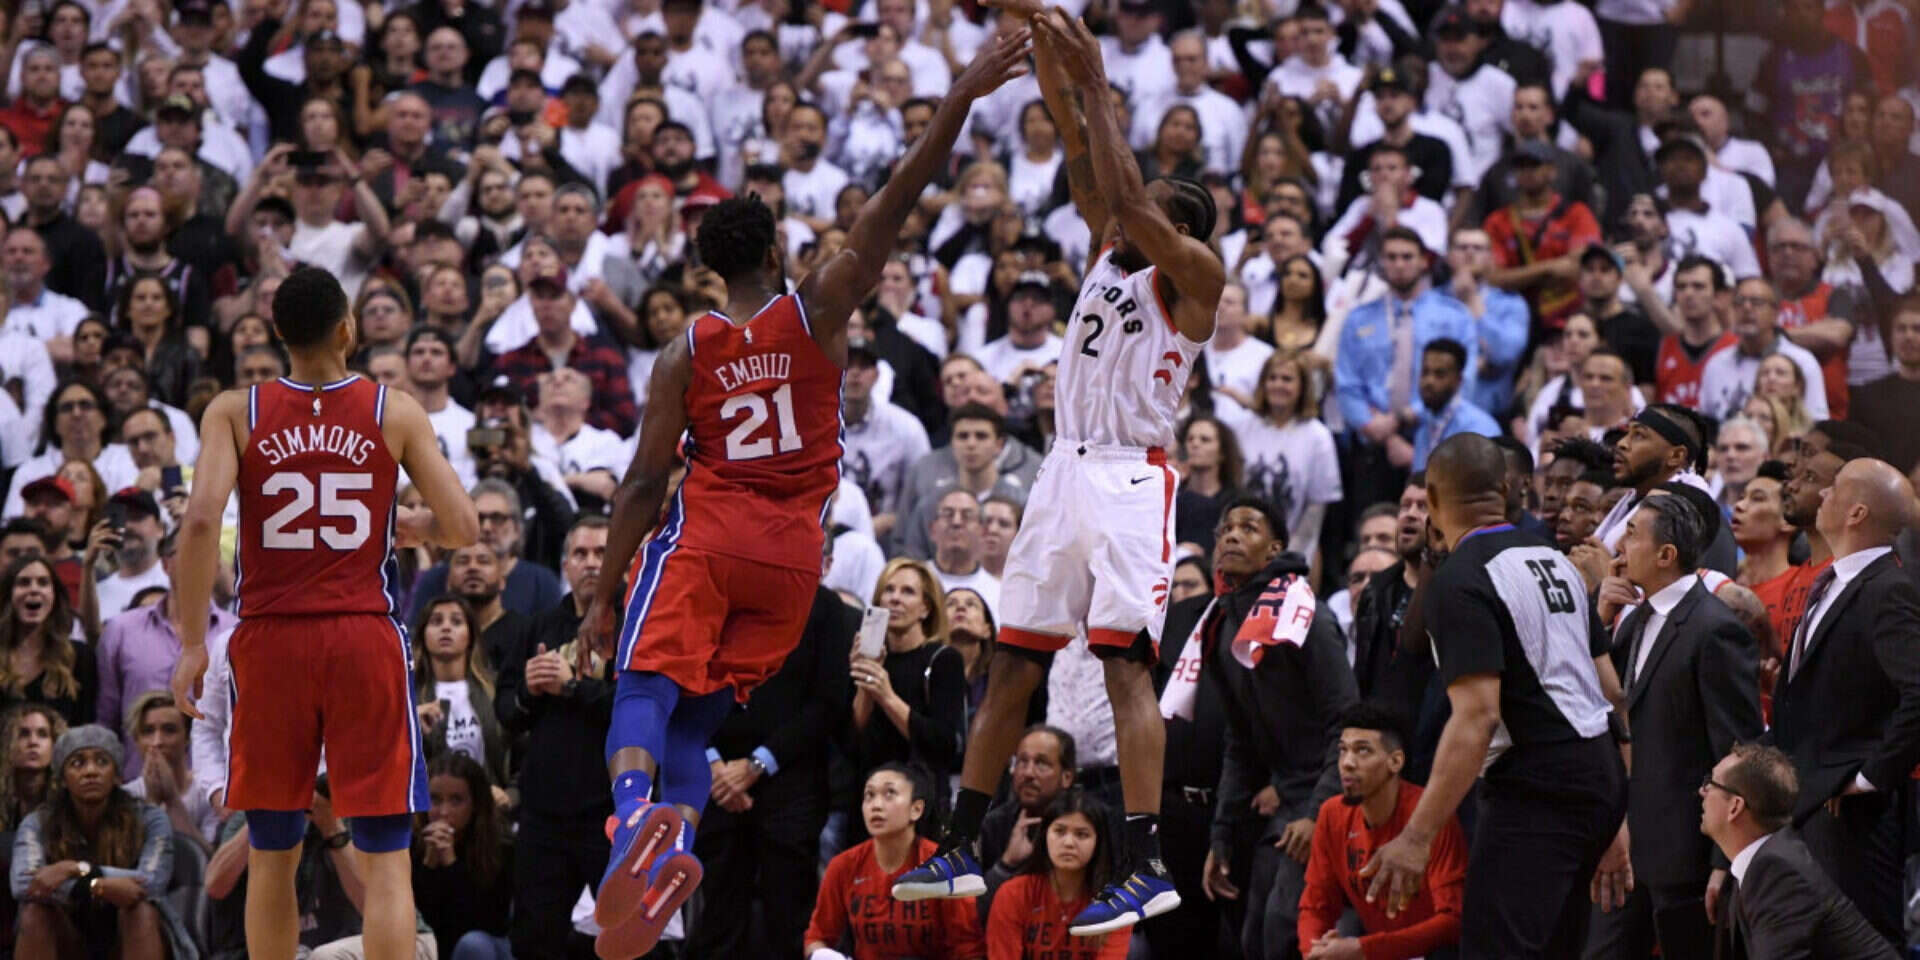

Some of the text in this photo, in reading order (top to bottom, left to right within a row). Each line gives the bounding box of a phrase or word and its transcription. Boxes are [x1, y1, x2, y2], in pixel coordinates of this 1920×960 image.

[1081, 313, 1105, 357] 2
[714, 352, 792, 393] EMBIID
[257, 424, 376, 466] SIMMONS
[720, 383, 803, 461] 21
[261, 472, 374, 550] 25
[1525, 559, 1577, 614] 25
